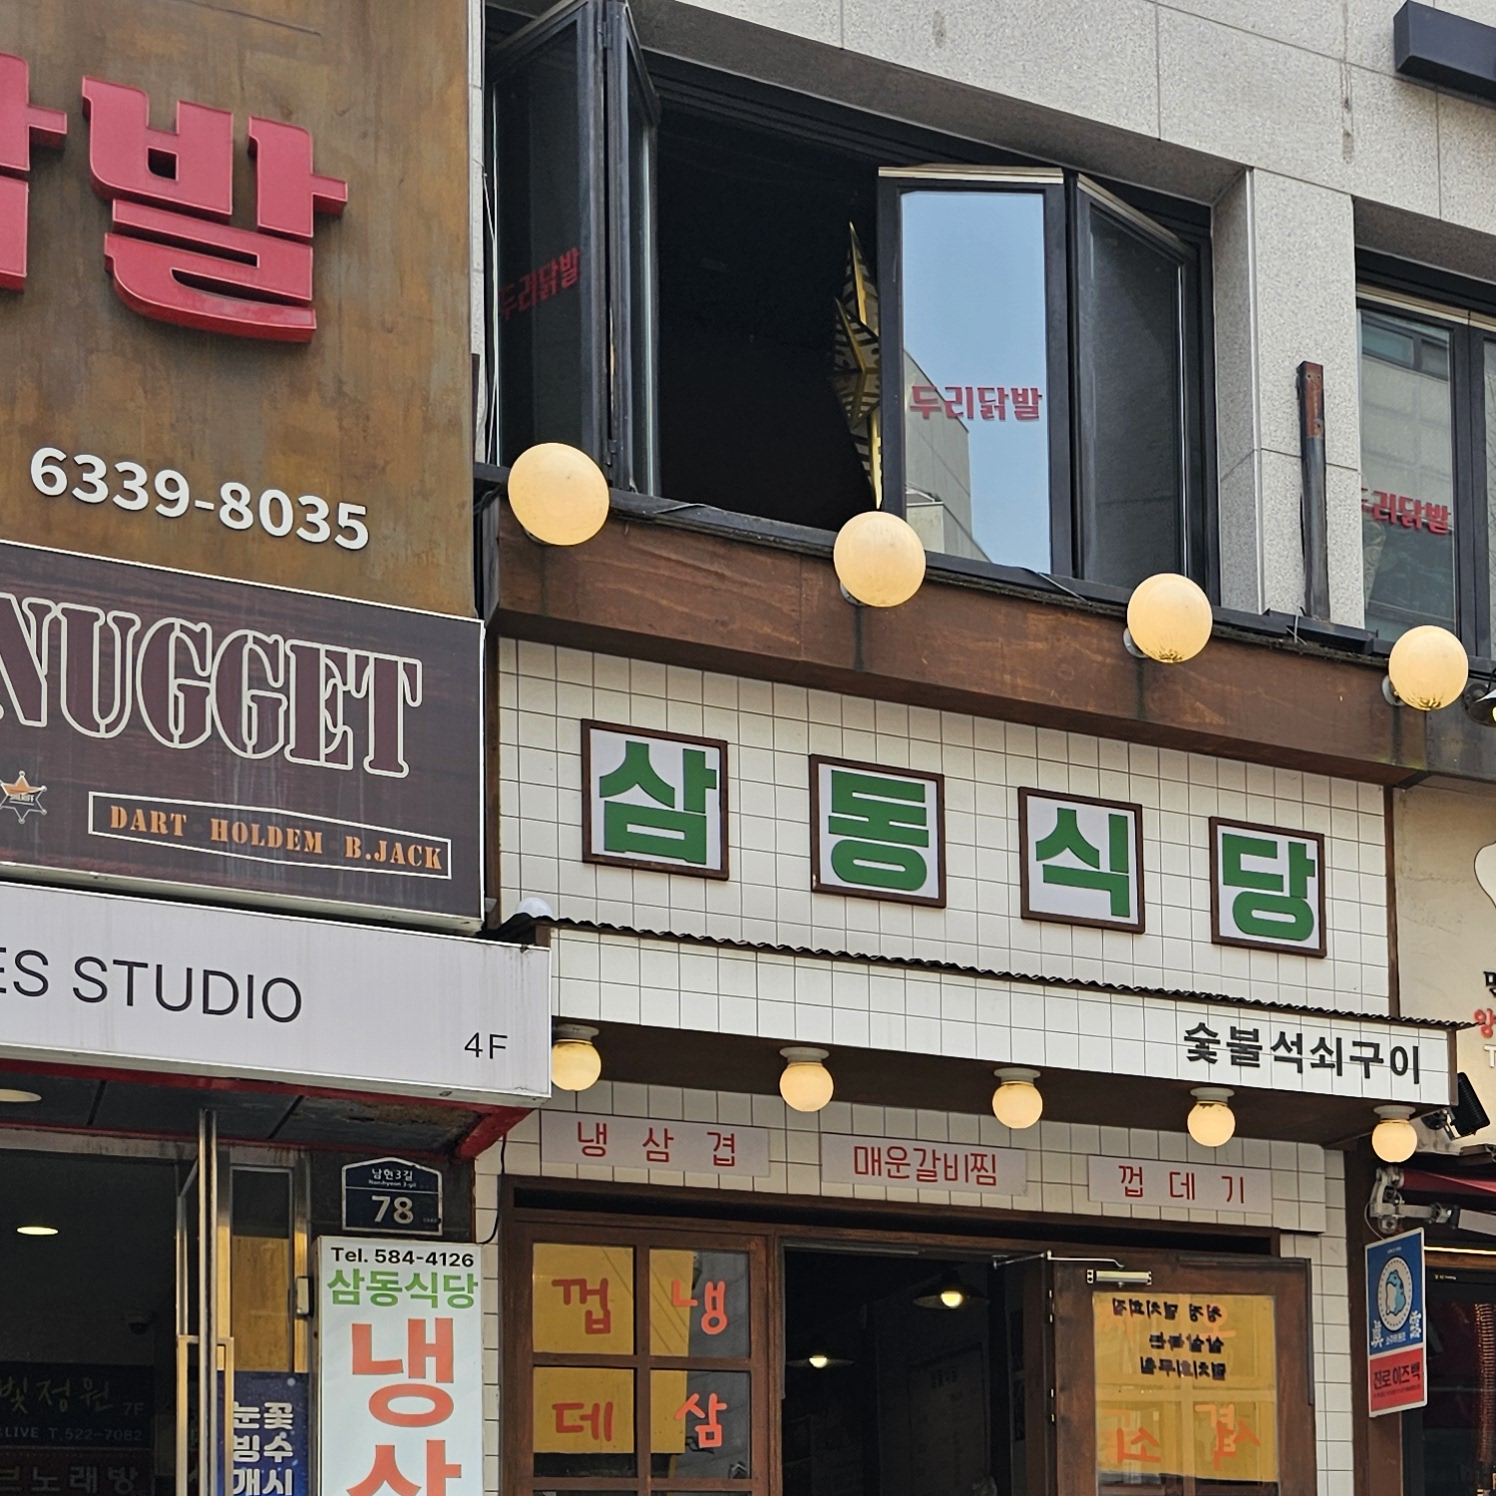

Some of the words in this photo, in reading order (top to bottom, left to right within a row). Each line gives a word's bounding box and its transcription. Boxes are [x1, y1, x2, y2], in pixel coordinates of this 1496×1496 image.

[501, 248, 580, 321] 두리닭발
[910, 384, 1043, 421] 두리닭발
[29, 446, 370, 552] 6339-8035
[0, 592, 423, 778] NUGGET
[110, 805, 187, 838] DART
[210, 818, 323, 856] HOLDEM
[345, 835, 444, 870] B.JACK
[0, 948, 49, 997] S
[72, 956, 302, 1023] STUDIO
[463, 1032, 508, 1060] 4F
[1184, 1021, 1422, 1086] 숯불석쇠구이
[576, 1121, 737, 1168] 냉삼겹
[371, 1168, 413, 1182] 남현3길
[853, 1145, 998, 1187] 매운갈비찜
[1117, 1165, 1246, 1204] 껍데기
[371, 1195, 414, 1224] 78
[331, 1246, 369, 1263] Tel.
[375, 1247, 474, 1267] 584-4126
[327, 1267, 479, 1308] 삼동식당
[234, 1435, 293, 1462] 빙수
[234, 1469, 292, 1496] 개시
